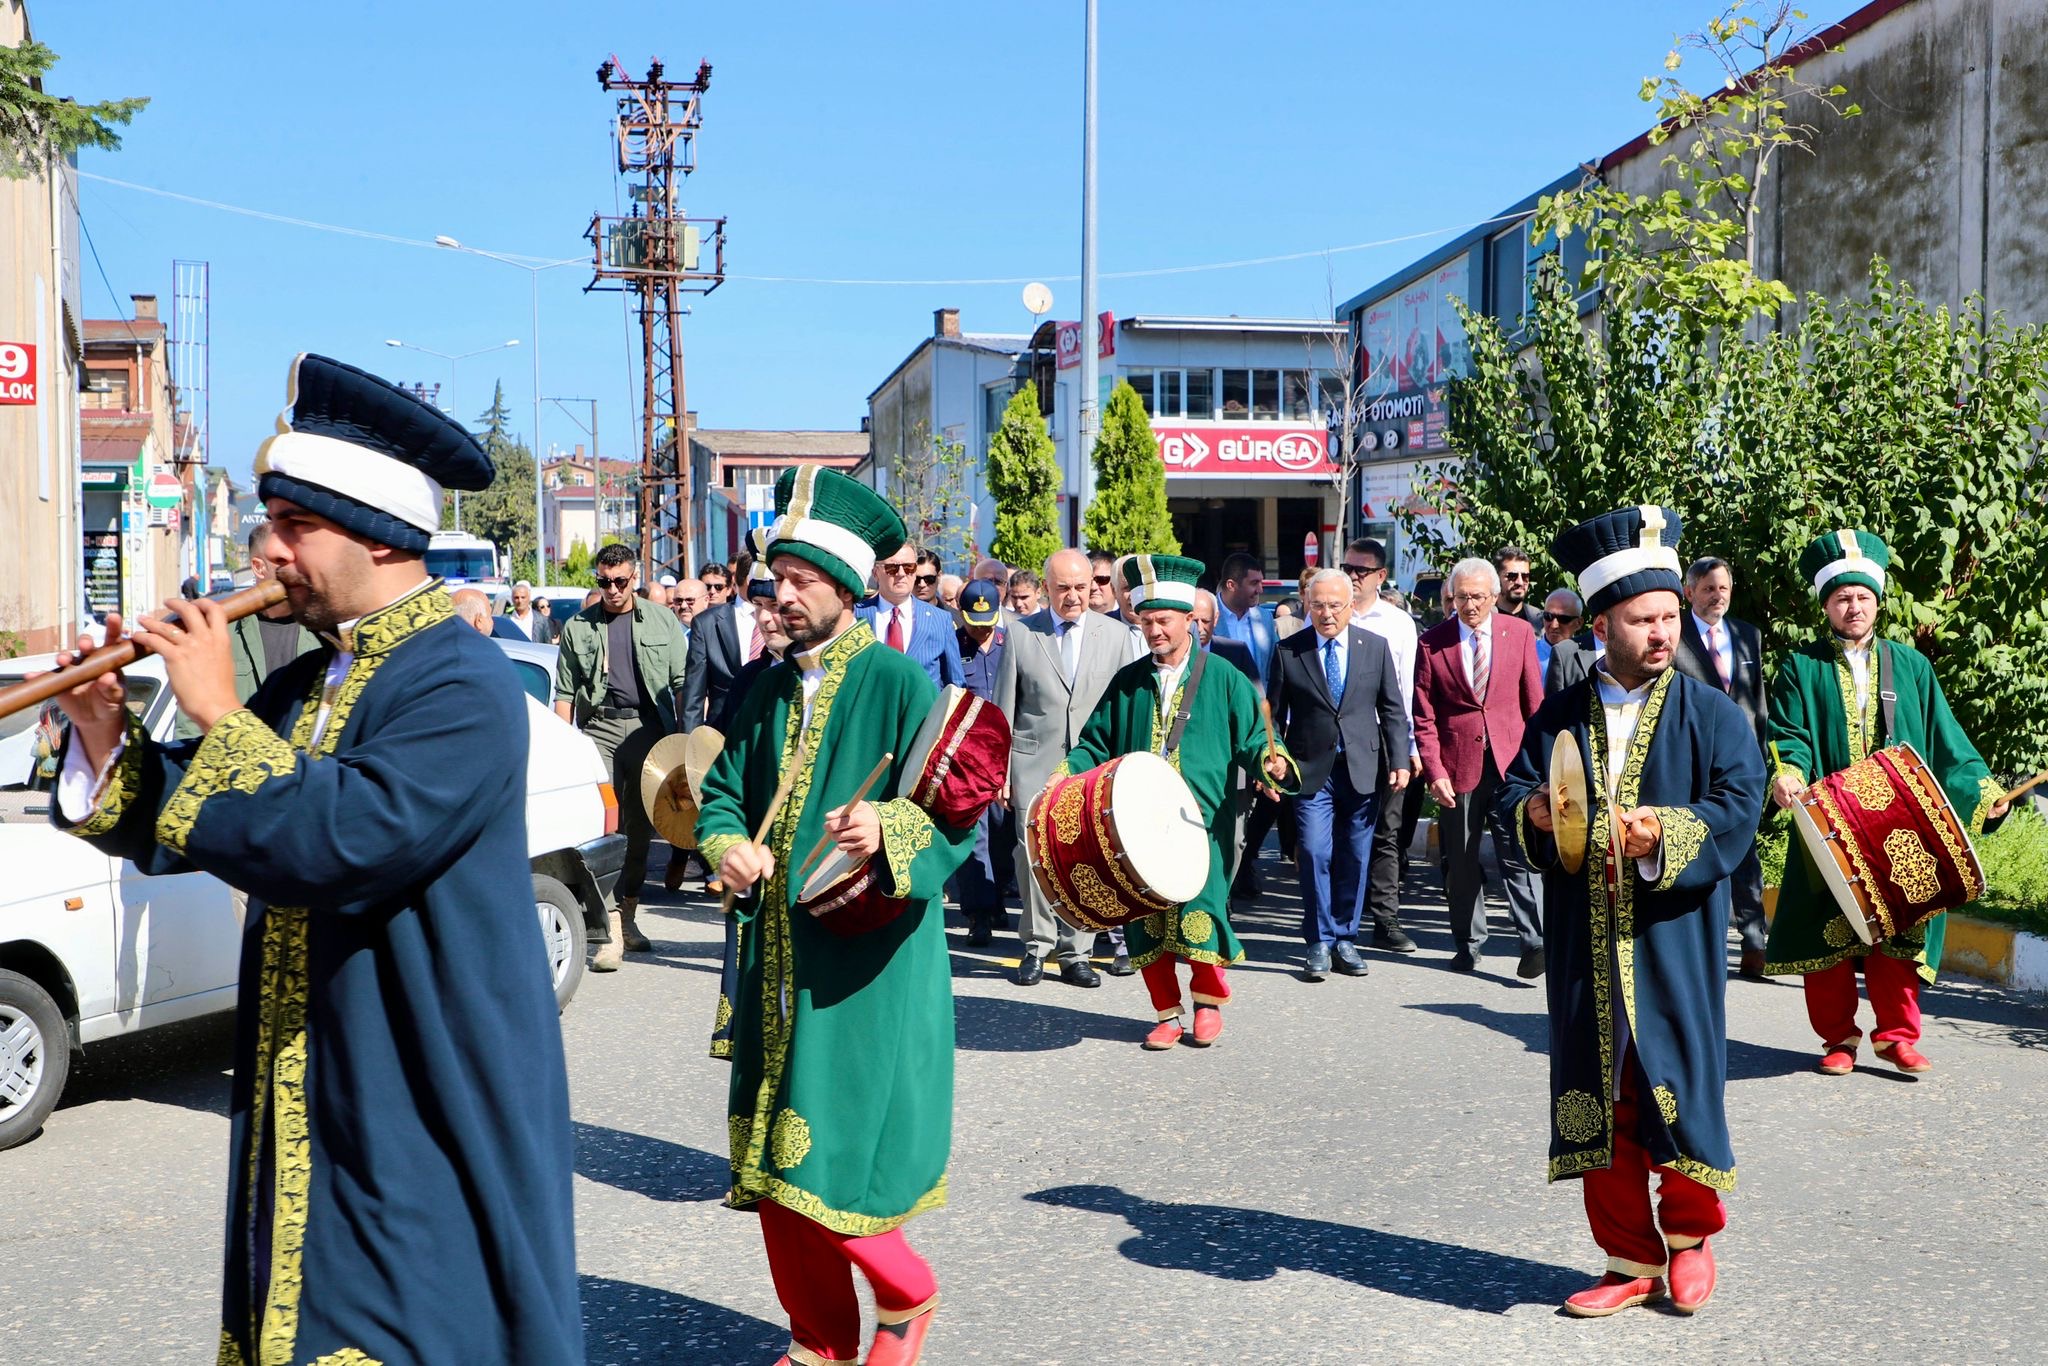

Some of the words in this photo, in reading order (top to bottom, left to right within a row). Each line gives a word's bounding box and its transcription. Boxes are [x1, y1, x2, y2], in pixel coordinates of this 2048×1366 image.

[0, 344, 29, 379] 9
[0, 382, 35, 400] LOK
[1218, 435, 1315, 462] GÜRSA
